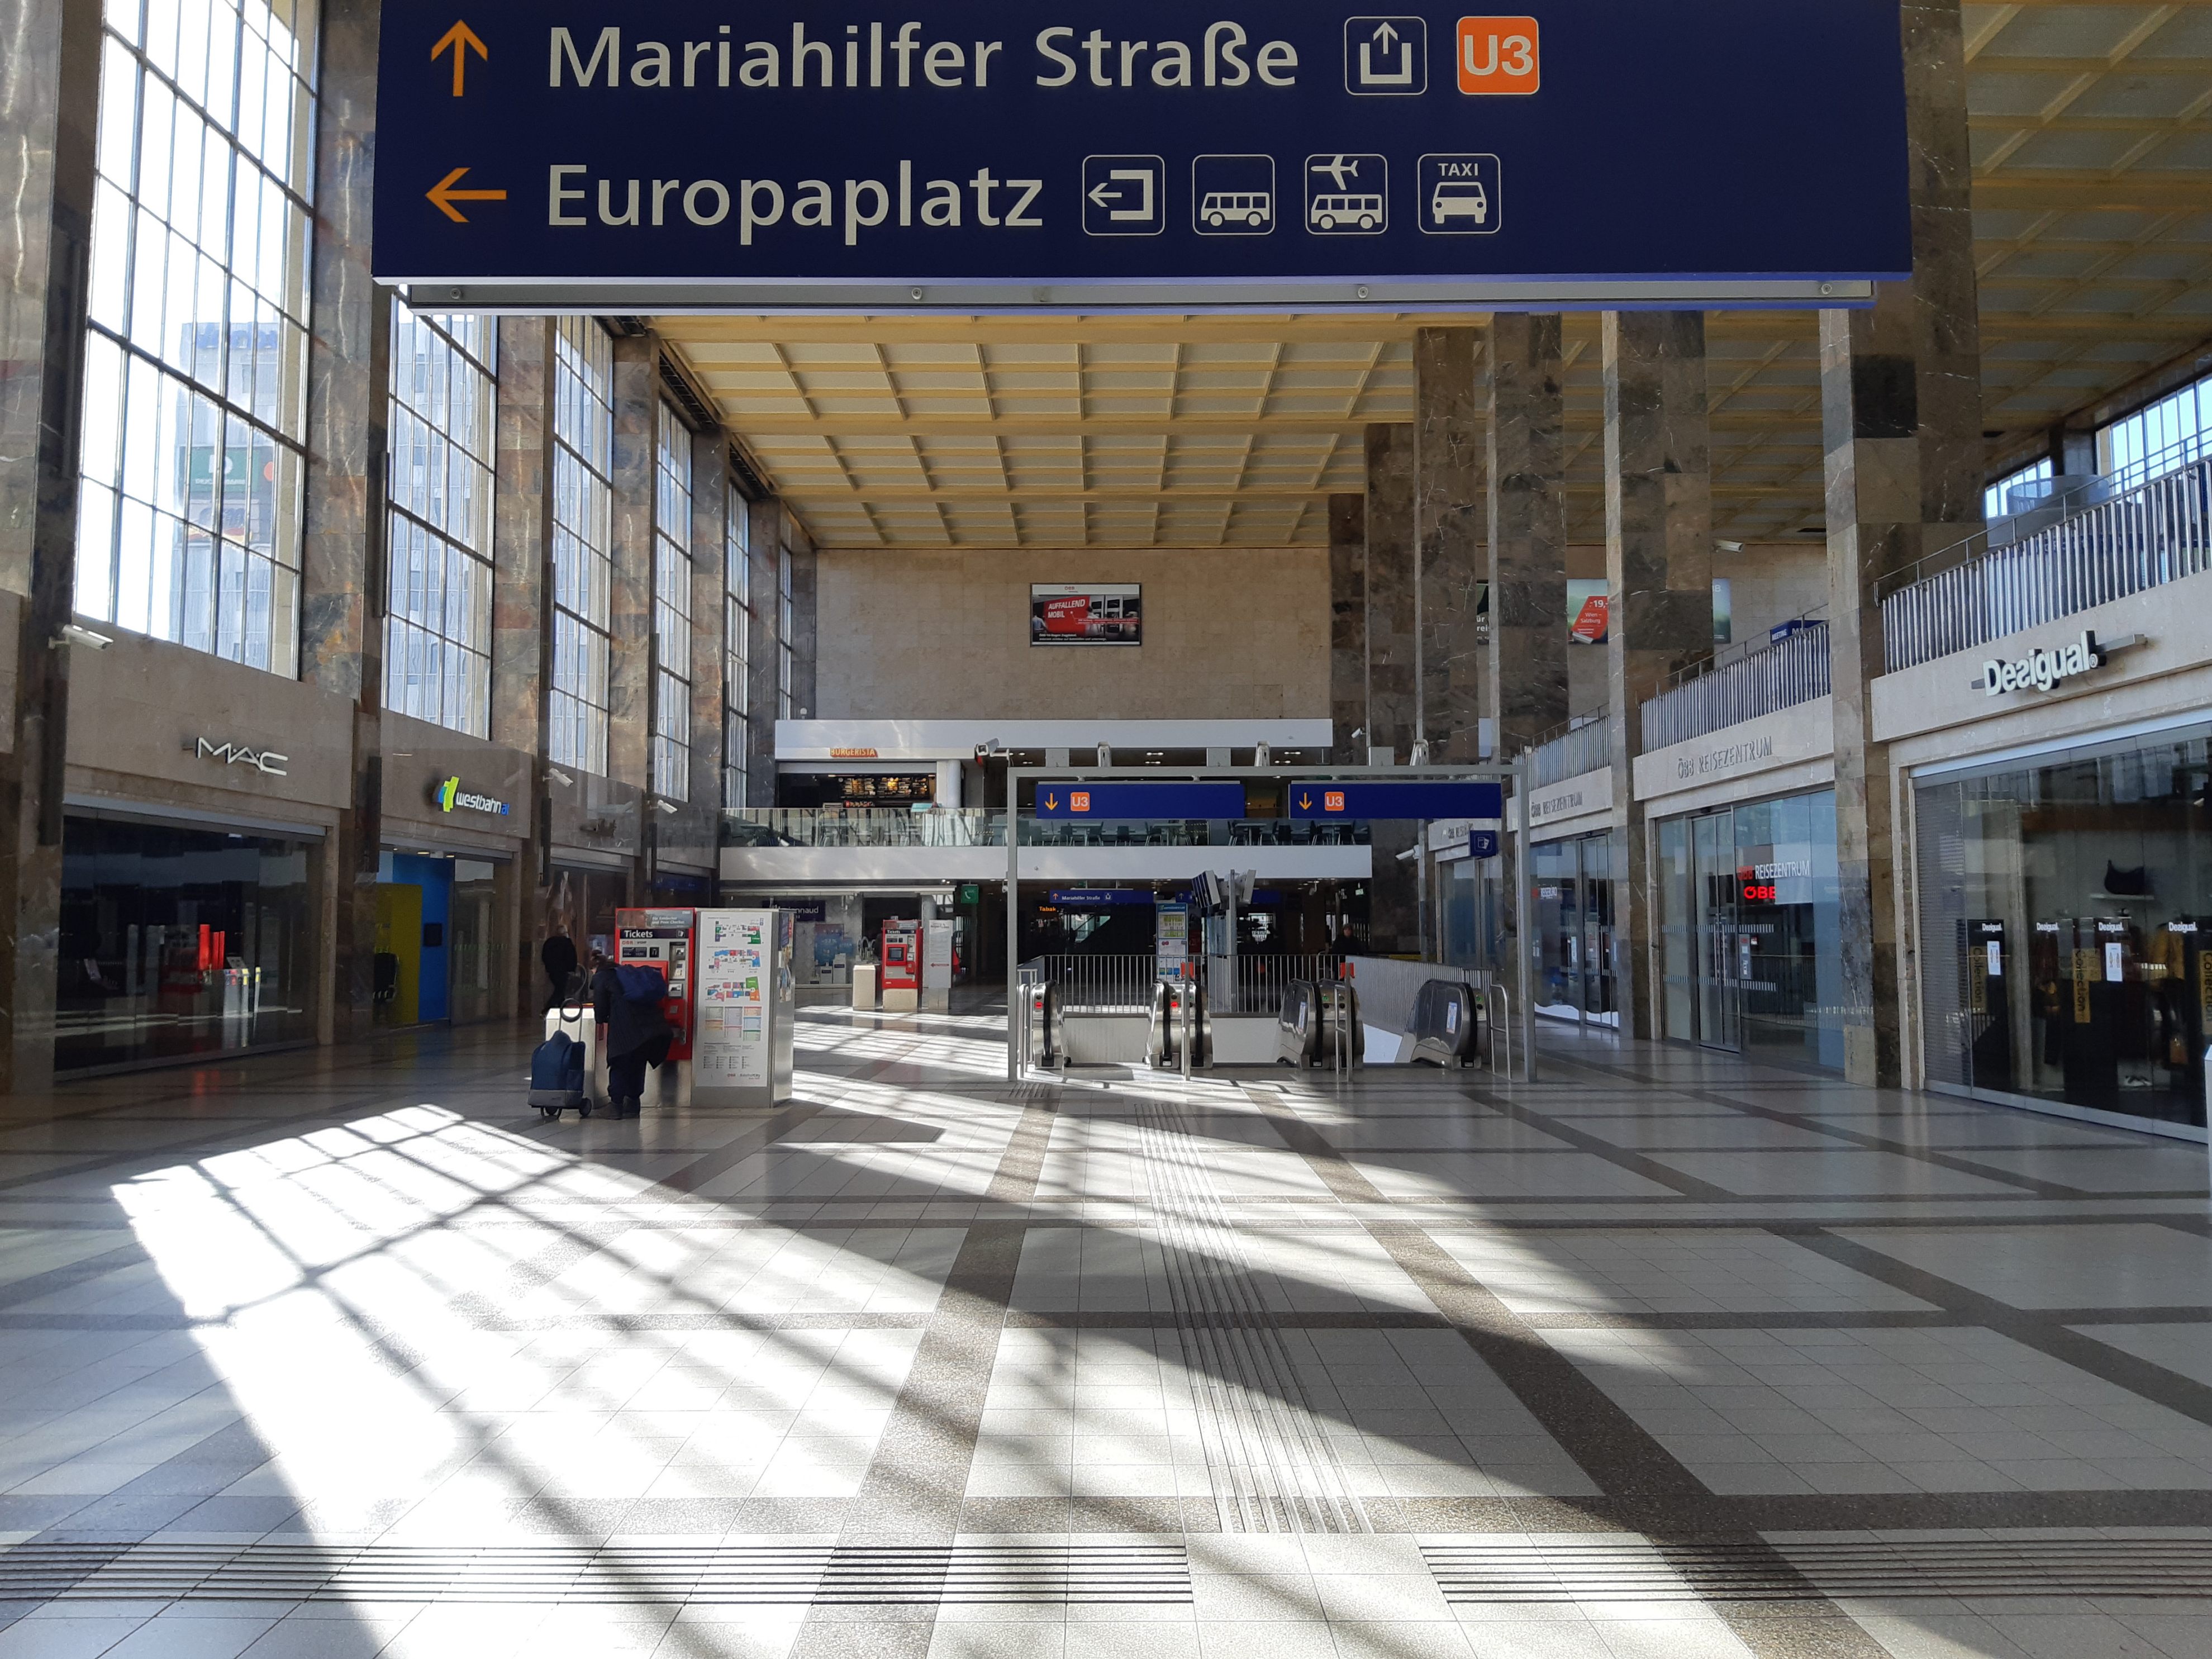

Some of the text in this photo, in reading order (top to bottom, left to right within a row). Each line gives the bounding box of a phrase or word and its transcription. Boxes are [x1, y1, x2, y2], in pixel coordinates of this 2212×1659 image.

[550, 21, 1534, 87] Mariahilfer Straße U3
[1438, 163, 1478, 176] TAXI
[549, 160, 1043, 245] Europaplatz
[1048, 598, 1086, 610] AUFFALLEND
[830, 748, 876, 757] BURGERISTA
[1678, 735, 1773, 779] ÖBB REISEZENTRUM
[1072, 796, 1088, 807] U3
[1326, 796, 1343, 806] U3
[1543, 791, 1583, 815] REISEZENTRUM
[1755, 860, 1810, 880] REISEZENTRUM
[624, 929, 653, 938] Tickets
[1973, 947, 1982, 1003] Collection
